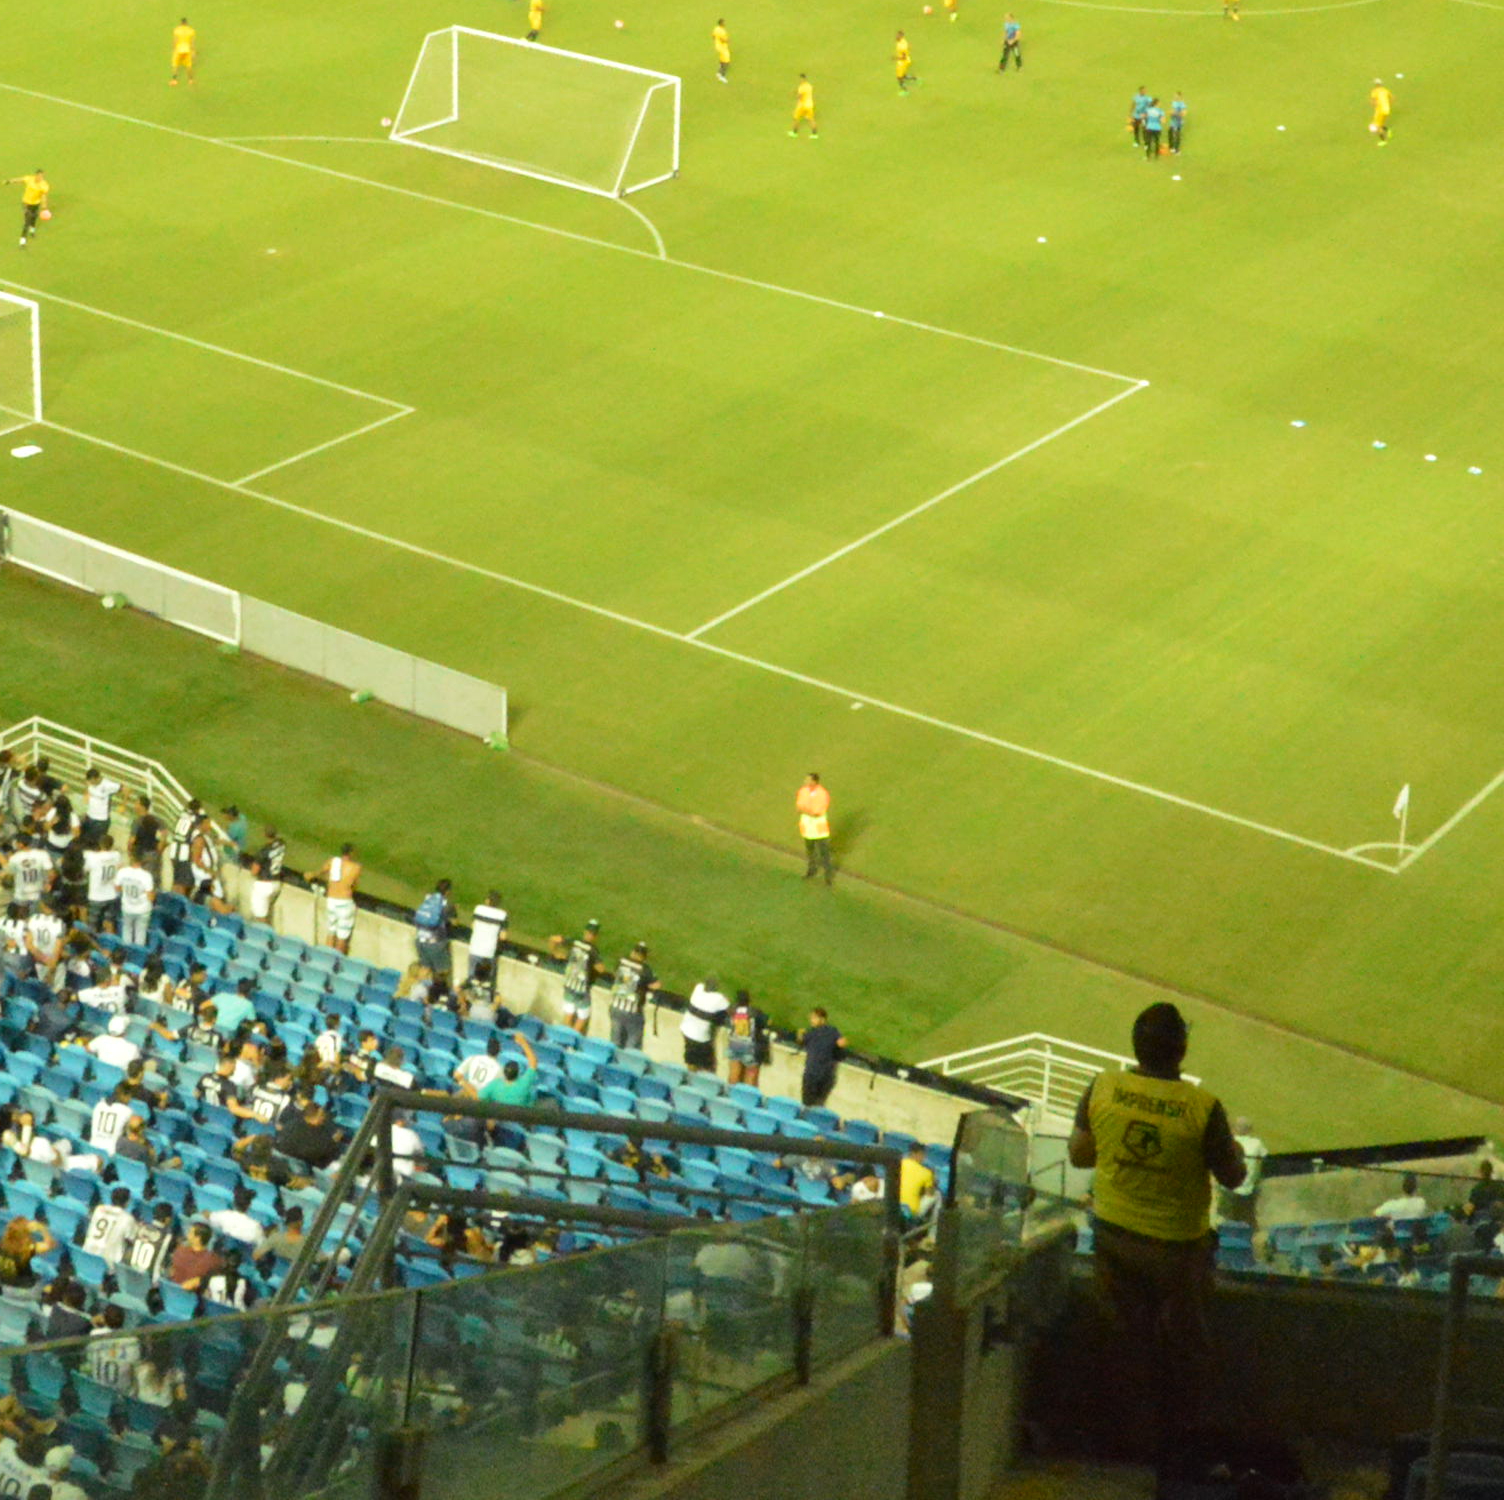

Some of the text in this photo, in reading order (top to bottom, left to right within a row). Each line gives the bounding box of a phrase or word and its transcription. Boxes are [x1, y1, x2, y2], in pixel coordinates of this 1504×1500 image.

[37, 928, 51, 946] 10
[473, 1066, 487, 1083] 10
[98, 1111, 117, 1136] 10
[131, 1240, 155, 1271] 10
